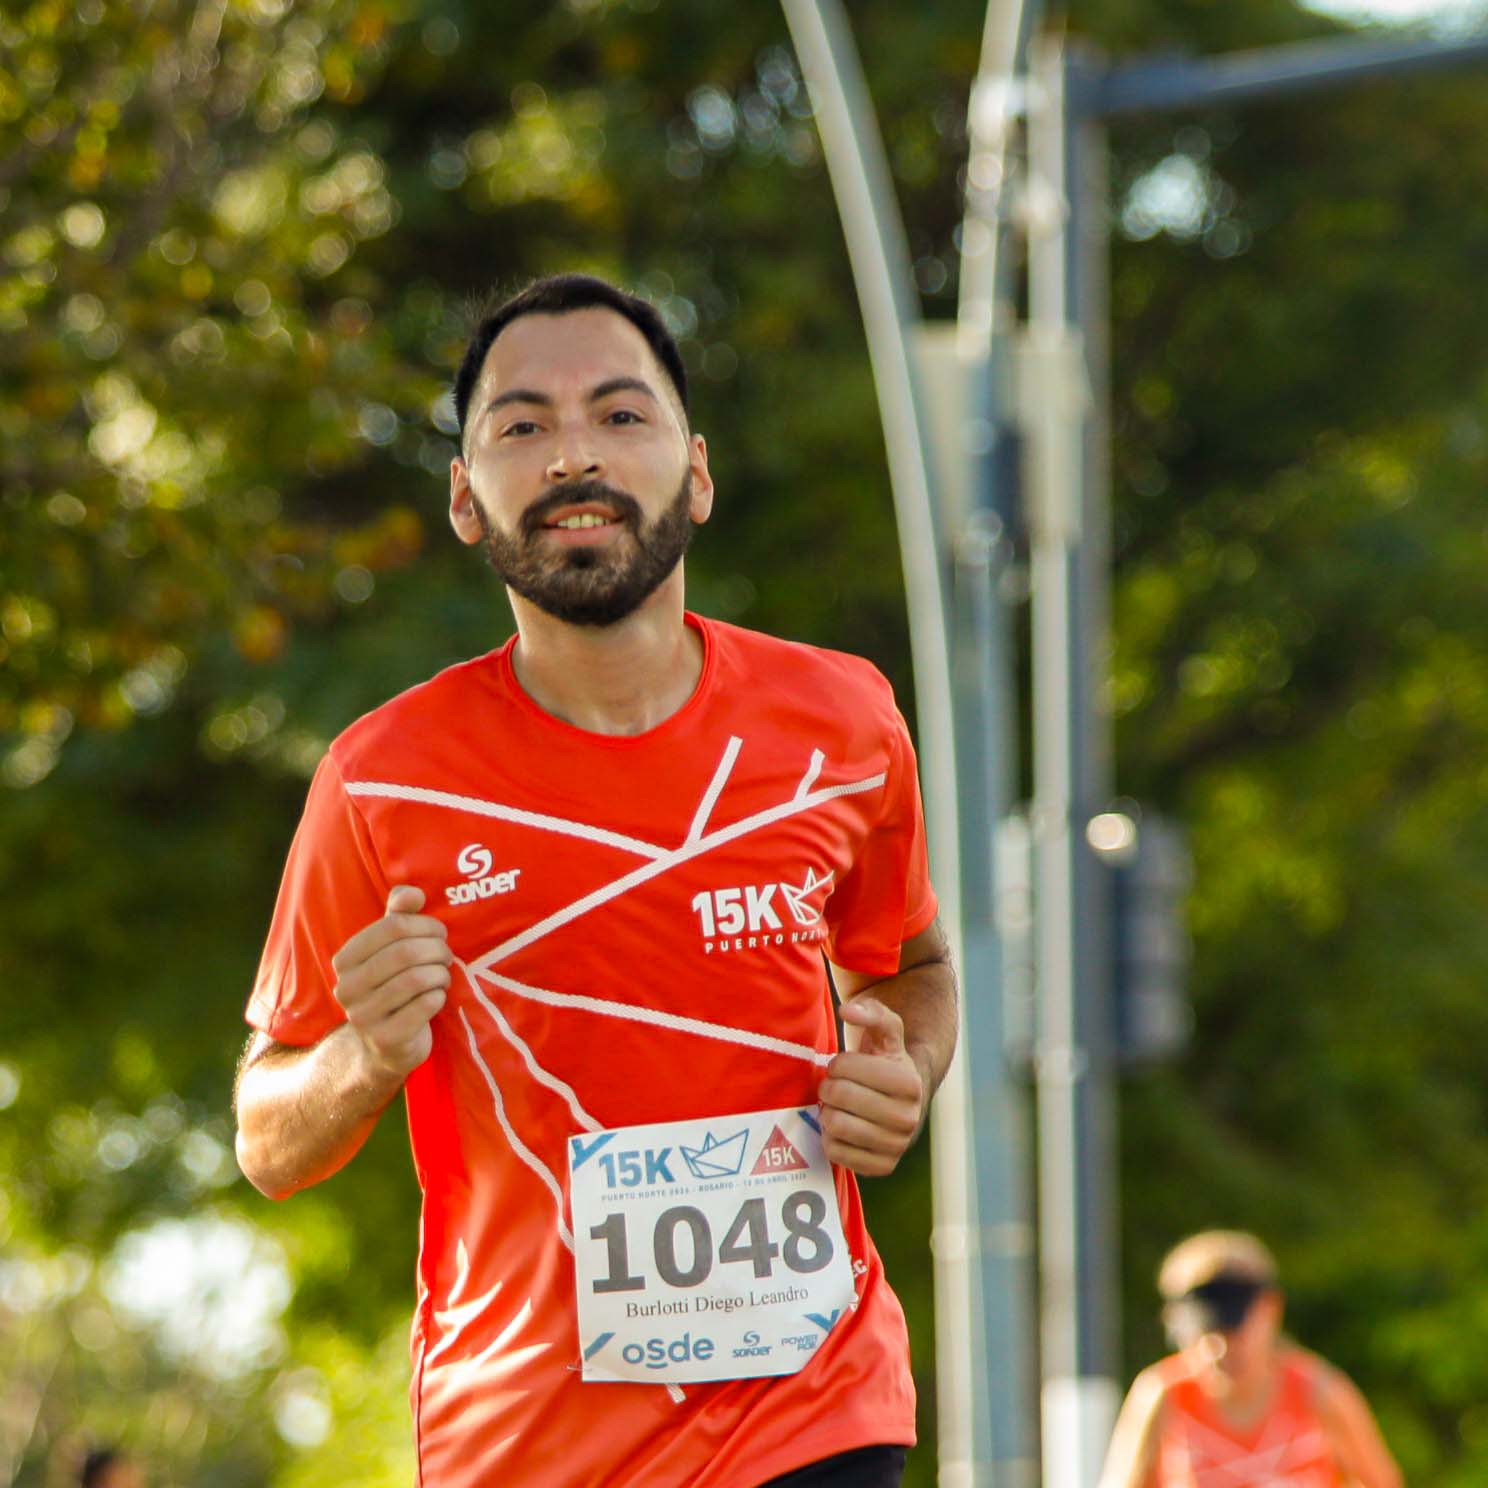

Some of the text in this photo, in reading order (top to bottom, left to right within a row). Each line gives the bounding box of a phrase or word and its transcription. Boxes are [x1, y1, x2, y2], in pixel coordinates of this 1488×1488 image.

[692, 884, 783, 937] 15K
[705, 933, 784, 954] PUERTO
[598, 1146, 676, 1188] 15K
[761, 1144, 796, 1168] 15K
[589, 1190, 834, 1293] 1048
[626, 1286, 809, 1318] Burlotti Diego Leandro
[622, 1331, 715, 1368] osde
